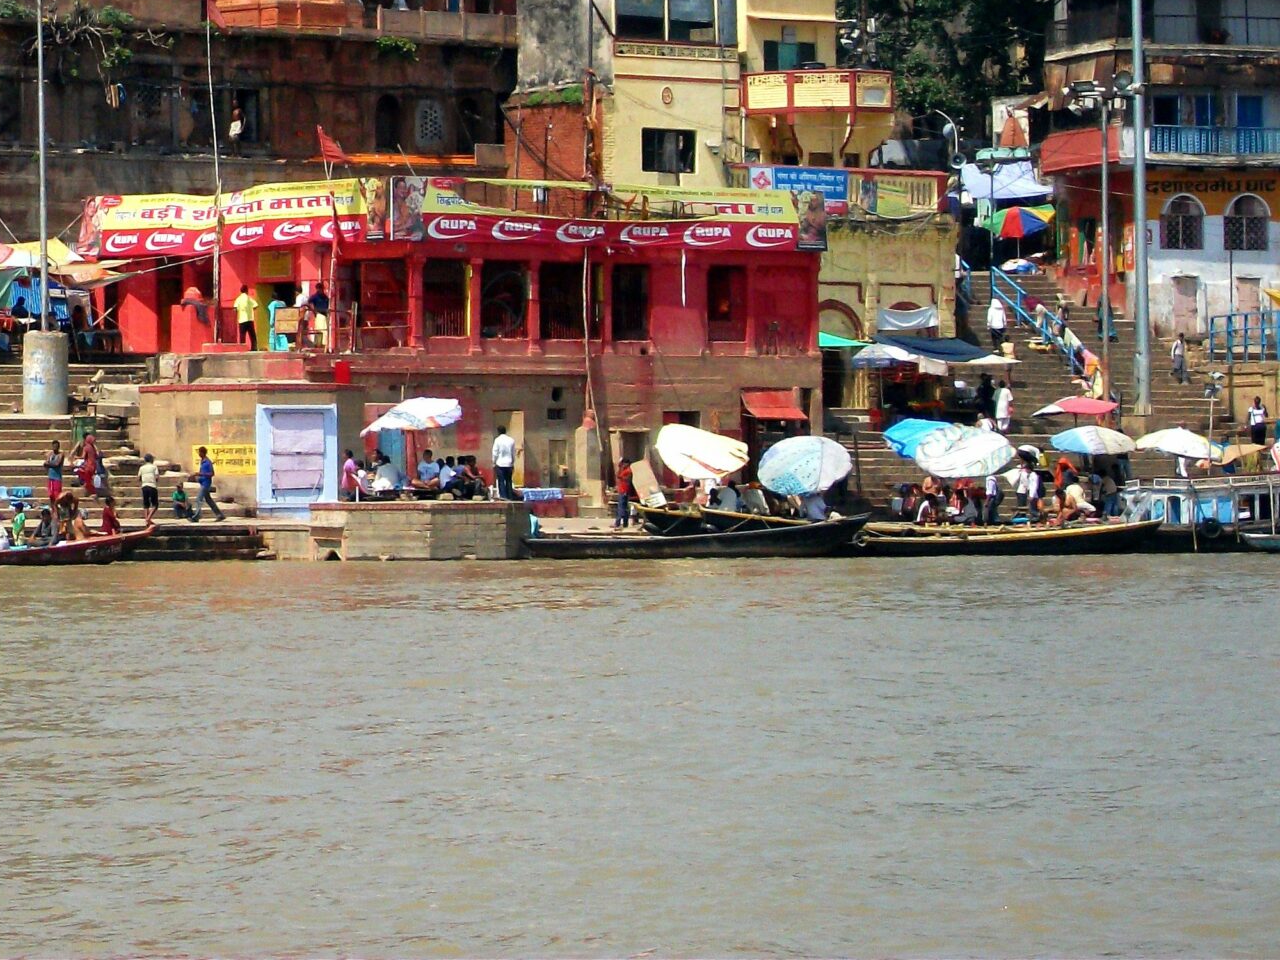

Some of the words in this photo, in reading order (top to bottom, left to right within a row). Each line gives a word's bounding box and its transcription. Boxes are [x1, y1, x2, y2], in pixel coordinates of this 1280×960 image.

[1246, 179, 1277, 193] घाट
[140, 204, 187, 221] बड़ी
[269, 194, 334, 210] माता
[440, 219, 477, 230] RUPA
[504, 221, 541, 232] RUPA
[238, 226, 264, 237] RUPA
[632, 226, 669, 237] RUPA
[694, 226, 732, 237] RUPA
[757, 227, 793, 239] RUPA
[113, 233, 139, 244] RUPA
[152, 233, 183, 244] RUPA
